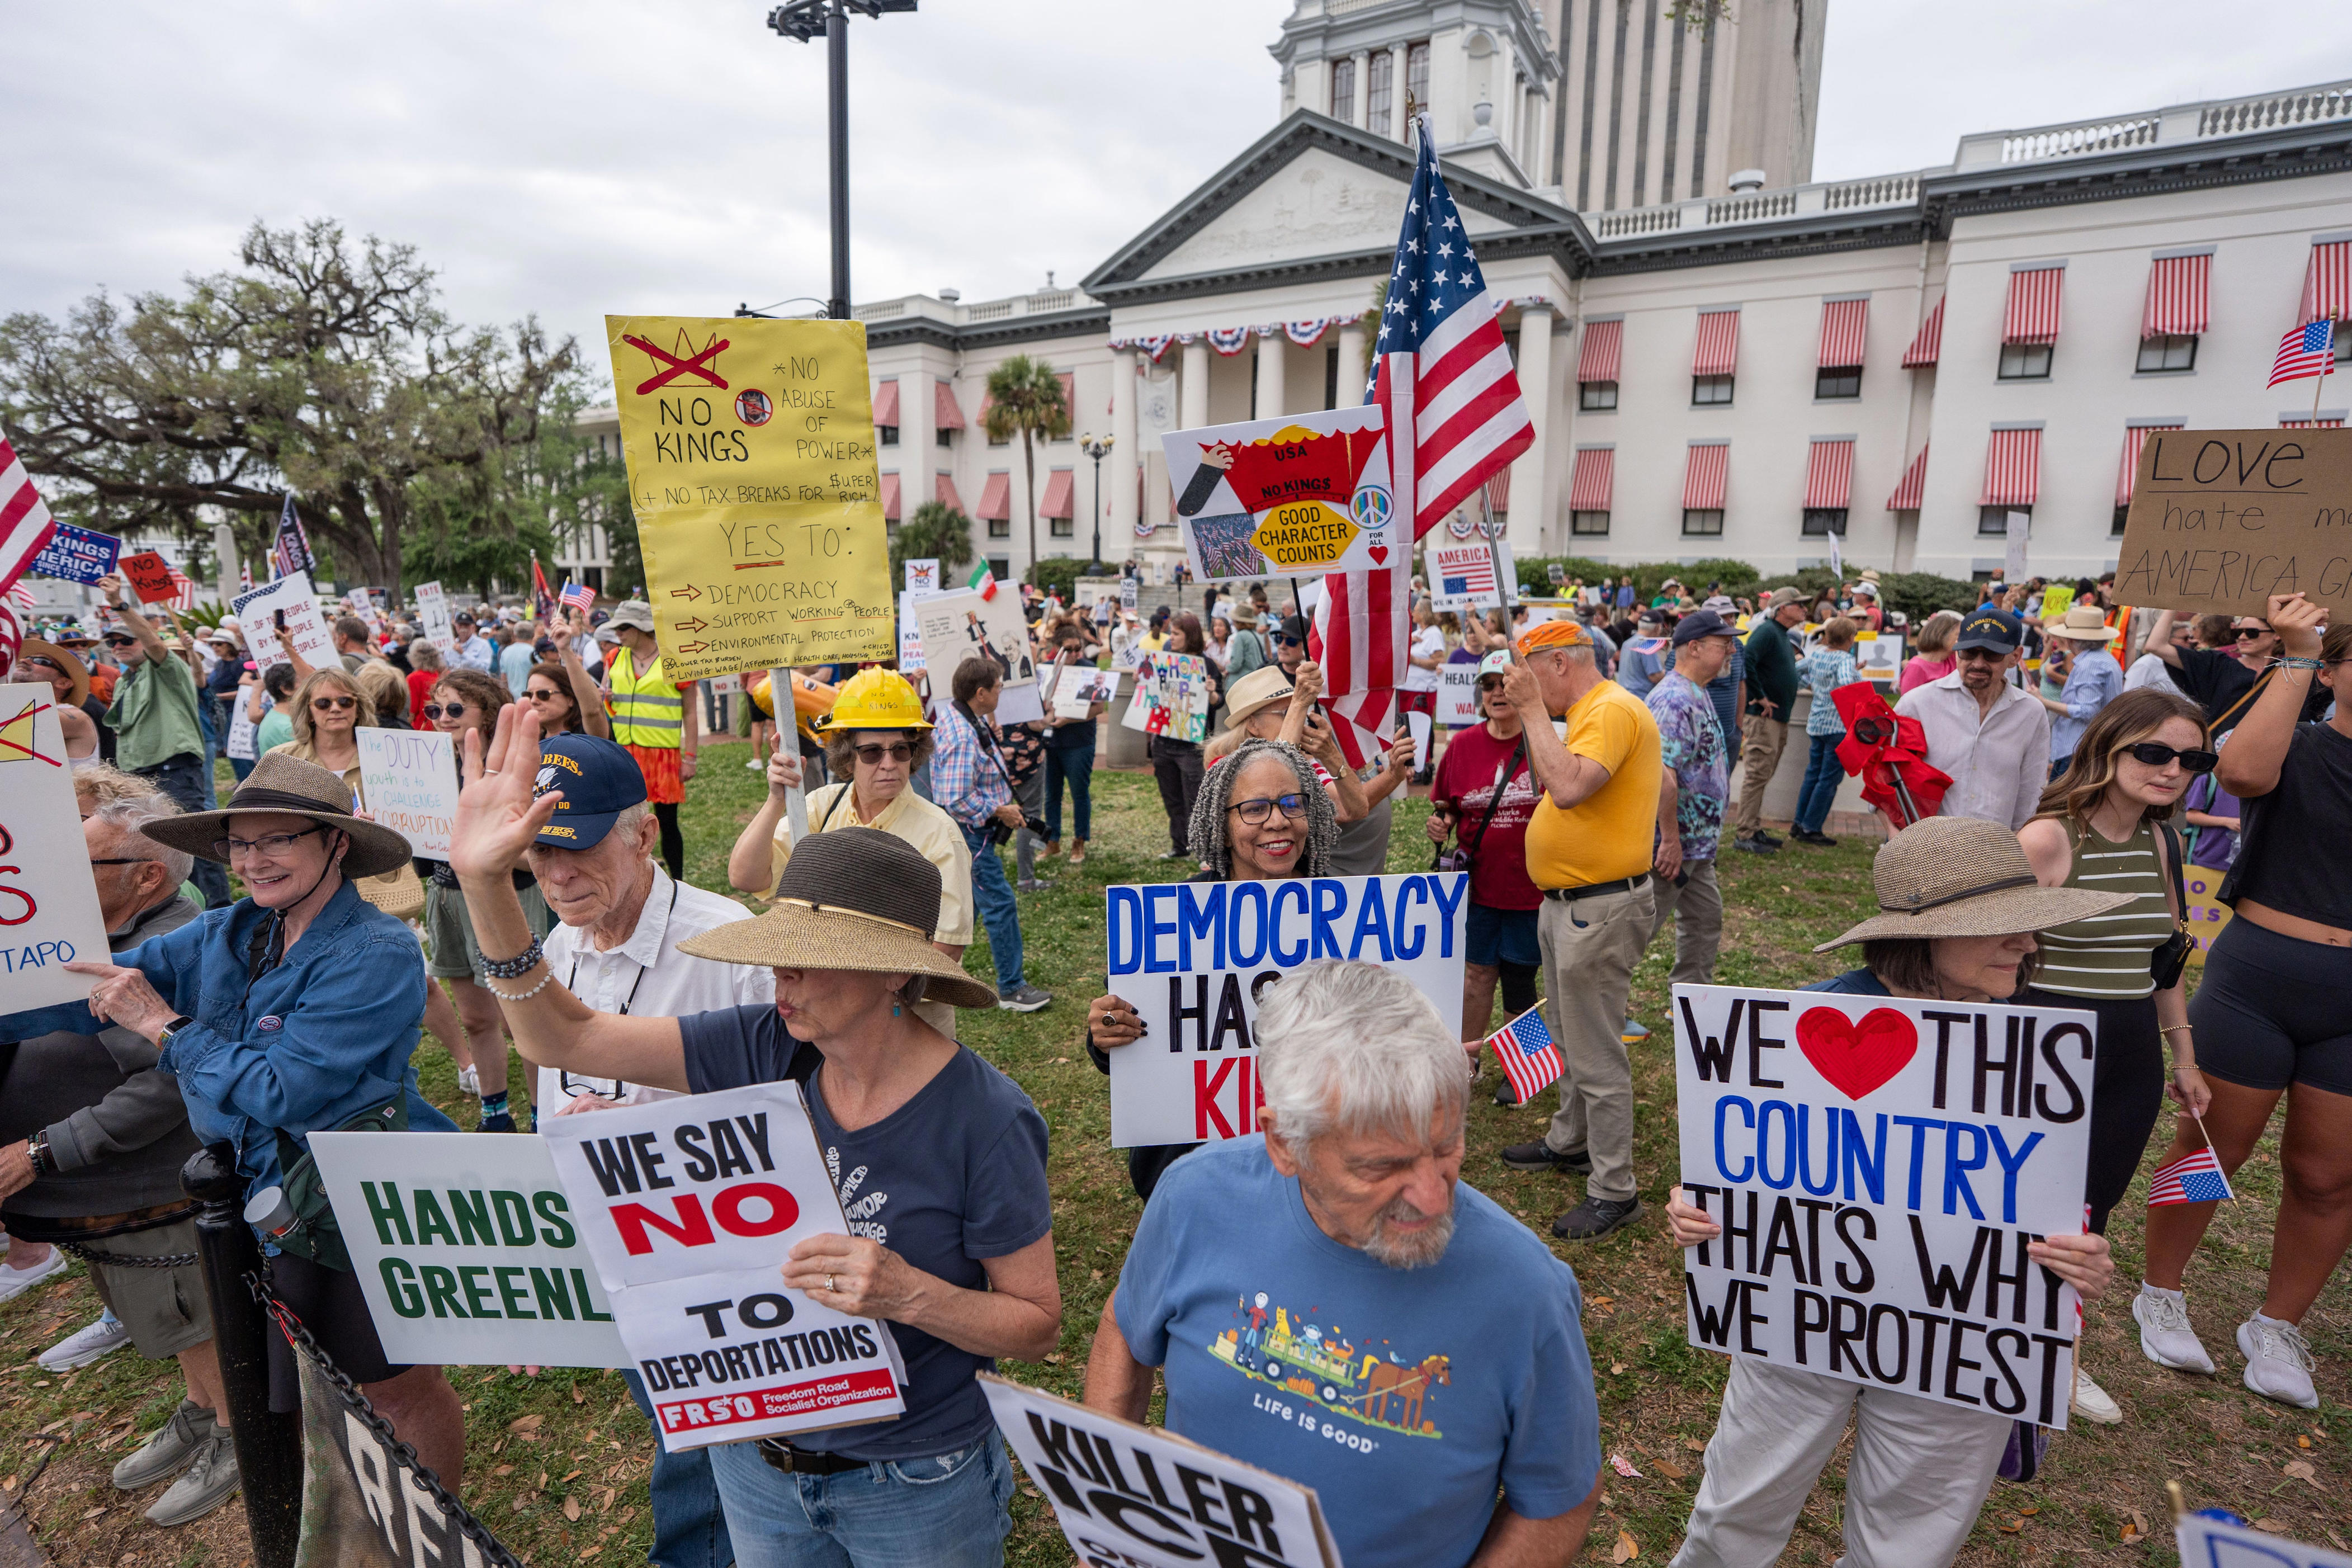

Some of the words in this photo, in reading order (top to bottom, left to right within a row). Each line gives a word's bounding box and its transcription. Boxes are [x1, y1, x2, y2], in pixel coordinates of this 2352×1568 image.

[791, 357, 818, 380] NO
[781, 389, 836, 409] ABUSE
[659, 397, 711, 426] NO
[805, 416, 829, 432] OF
[655, 429, 749, 463] KINGS
[797, 439, 860, 460] POWER
[1274, 445, 1307, 462] USA
[665, 487, 690, 504] NO
[696, 486, 730, 504] TAX
[738, 486, 790, 503] BREAKS
[799, 485, 824, 501] FOR
[1261, 484, 1281, 498] NO
[1284, 477, 1331, 493] KING$
[1279, 507, 1320, 525] GOOD
[2163, 499, 2265, 531] hate
[719, 522, 784, 557] YES
[800, 523, 853, 557] TO:
[1260, 523, 1348, 546] CHARACTER
[51, 535, 111, 559] KINGS
[58, 547, 68, 556] IN
[1277, 544, 1336, 563] COUNTS
[1438, 547, 1490, 565] AMERICA
[37, 561, 60, 571] SINCE
[63, 566, 82, 577] 1776
[132, 559, 154, 573] NO
[2120, 549, 2300, 599] AMERICA
[707, 580, 838, 604] DEMOCRACY
[282, 600, 311, 619] PEOPLE
[712, 611, 778, 629] SUPPORT
[787, 606, 845, 621] WORKING
[854, 606, 890, 618] PEOPLE
[257, 637, 268, 649] BY
[291, 619, 314, 636] EOPLE
[1991, 619, 2008, 633] GUARD
[711, 633, 804, 652] ENVIRONMENTAL
[811, 627, 875, 641] PROTECTION
[257, 657, 273, 669] FOR
[675, 659, 698, 668] LOWER
[678, 669, 711, 680] LIVING
[794, 655, 820, 663] HEALTH
[1123, 649, 1135, 665] NO
[1152, 653, 1206, 683] WHOA!
[1445, 672, 1476, 685] HEALT
[1135, 685, 1159, 709] The
[1145, 703, 1206, 742] BRAKES
[358, 731, 382, 752] The
[384, 734, 438, 772] DUTY
[442, 736, 452, 758] of
[540, 754, 579, 774] BEES
[365, 770, 398, 797] youth
[402, 778, 409, 786] is
[414, 776, 424, 787] to
[384, 790, 442, 809] CHALLENGE
[1498, 807, 1520, 816] Marks
[1108, 873, 1469, 975] DEMOCRACY
[2186, 905, 2220, 922] ES
[1679, 996, 1789, 1089] WE
[1921, 1010, 2093, 1123] THIS
[580, 1131, 676, 1197] WE
[674, 1112, 776, 1182] SAY
[1715, 1094, 2046, 1224] COUNTRY
[360, 1181, 576, 1249] HANDS
[845, 1192, 887, 1220] HUMOR
[608, 1182, 800, 1256] NO
[1682, 1183, 1877, 1295] THAT'S
[1908, 1214, 2064, 1330] WHY
[378, 1257, 615, 1322] GREENL
[684, 1293, 794, 1339] TO
[640, 1324, 879, 1392] DEPORTATIONS
[1685, 1273, 1768, 1357] WE
[1794, 1288, 2072, 1425] PROTEST
[662, 1396, 756, 1429] FRSO
[762, 1388, 816, 1404] Freedom
[818, 1379, 849, 1394] Road
[765, 1398, 816, 1415] Socialist
[816, 1386, 892, 1408] Organization
[1298, 1413, 1316, 1432] IS
[1321, 1423, 1373, 1454] GOOD
[1025, 1410, 1283, 1560] KILLER
